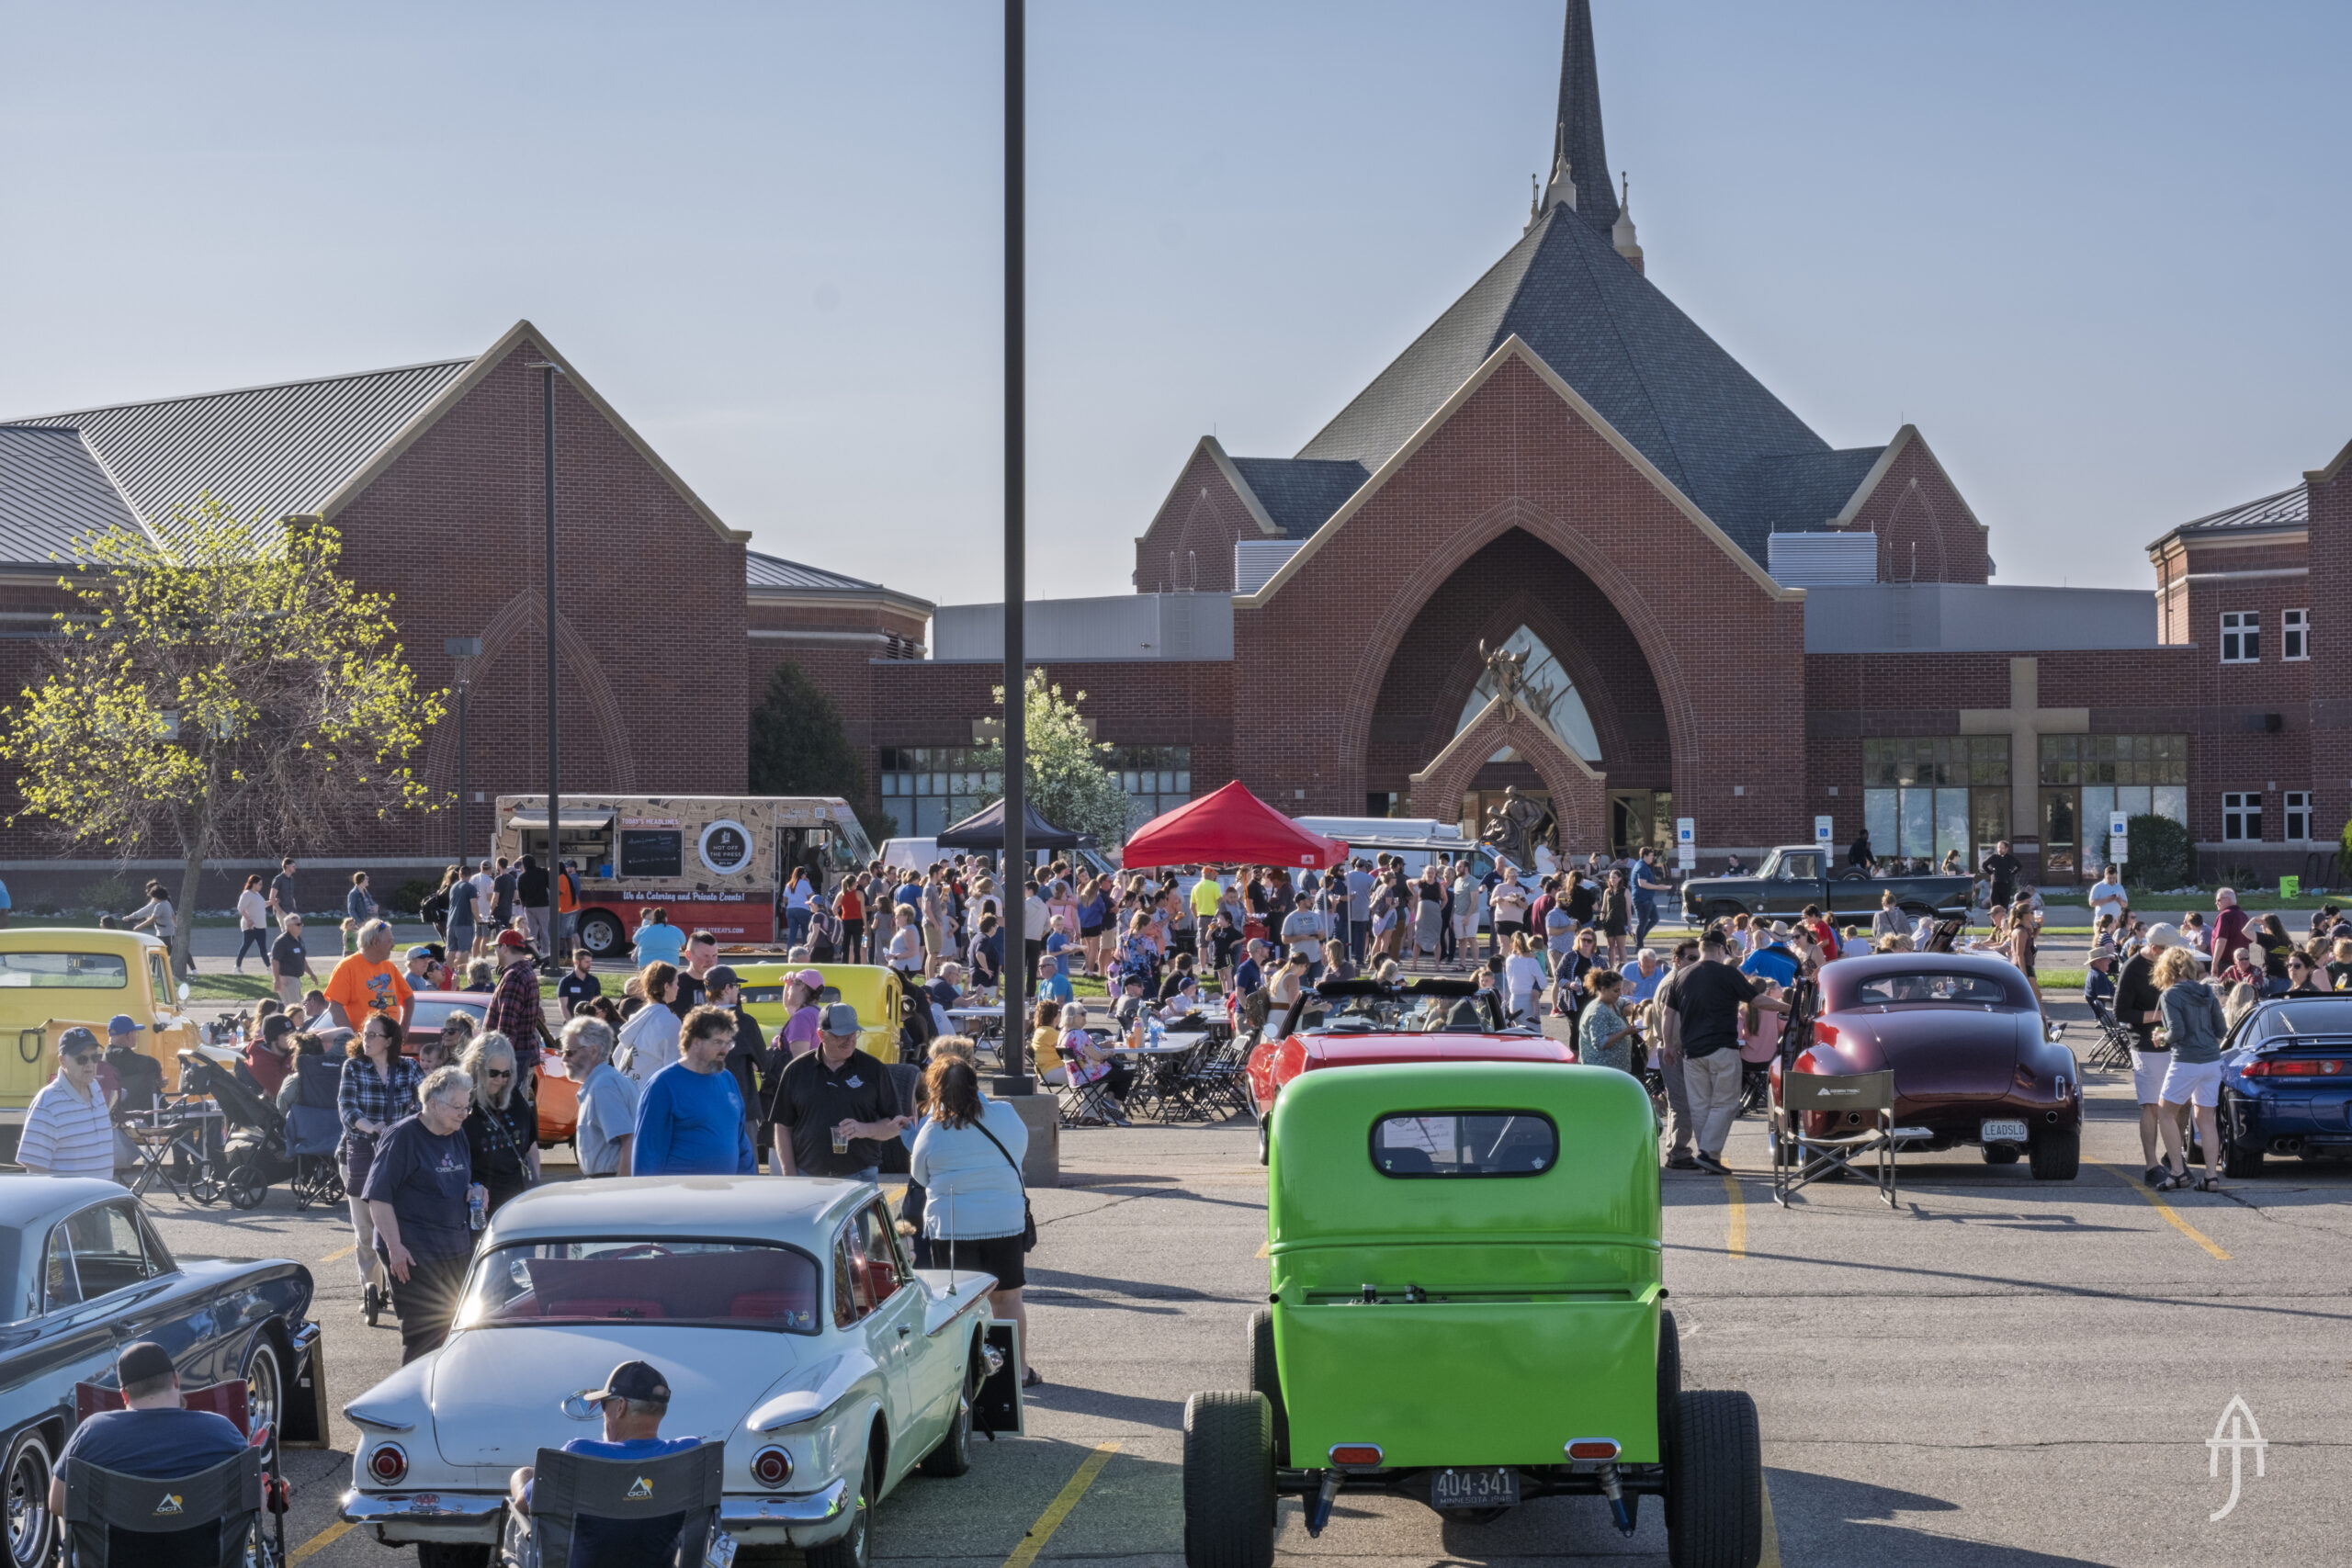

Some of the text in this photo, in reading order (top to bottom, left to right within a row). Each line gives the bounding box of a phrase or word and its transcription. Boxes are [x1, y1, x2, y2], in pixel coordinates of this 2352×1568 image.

[623, 890, 745, 902] We do Catering and Private Events!
[1984, 1124, 2025, 1135] LEADSLD
[1440, 1496, 1487, 1505] MINNESOTA
